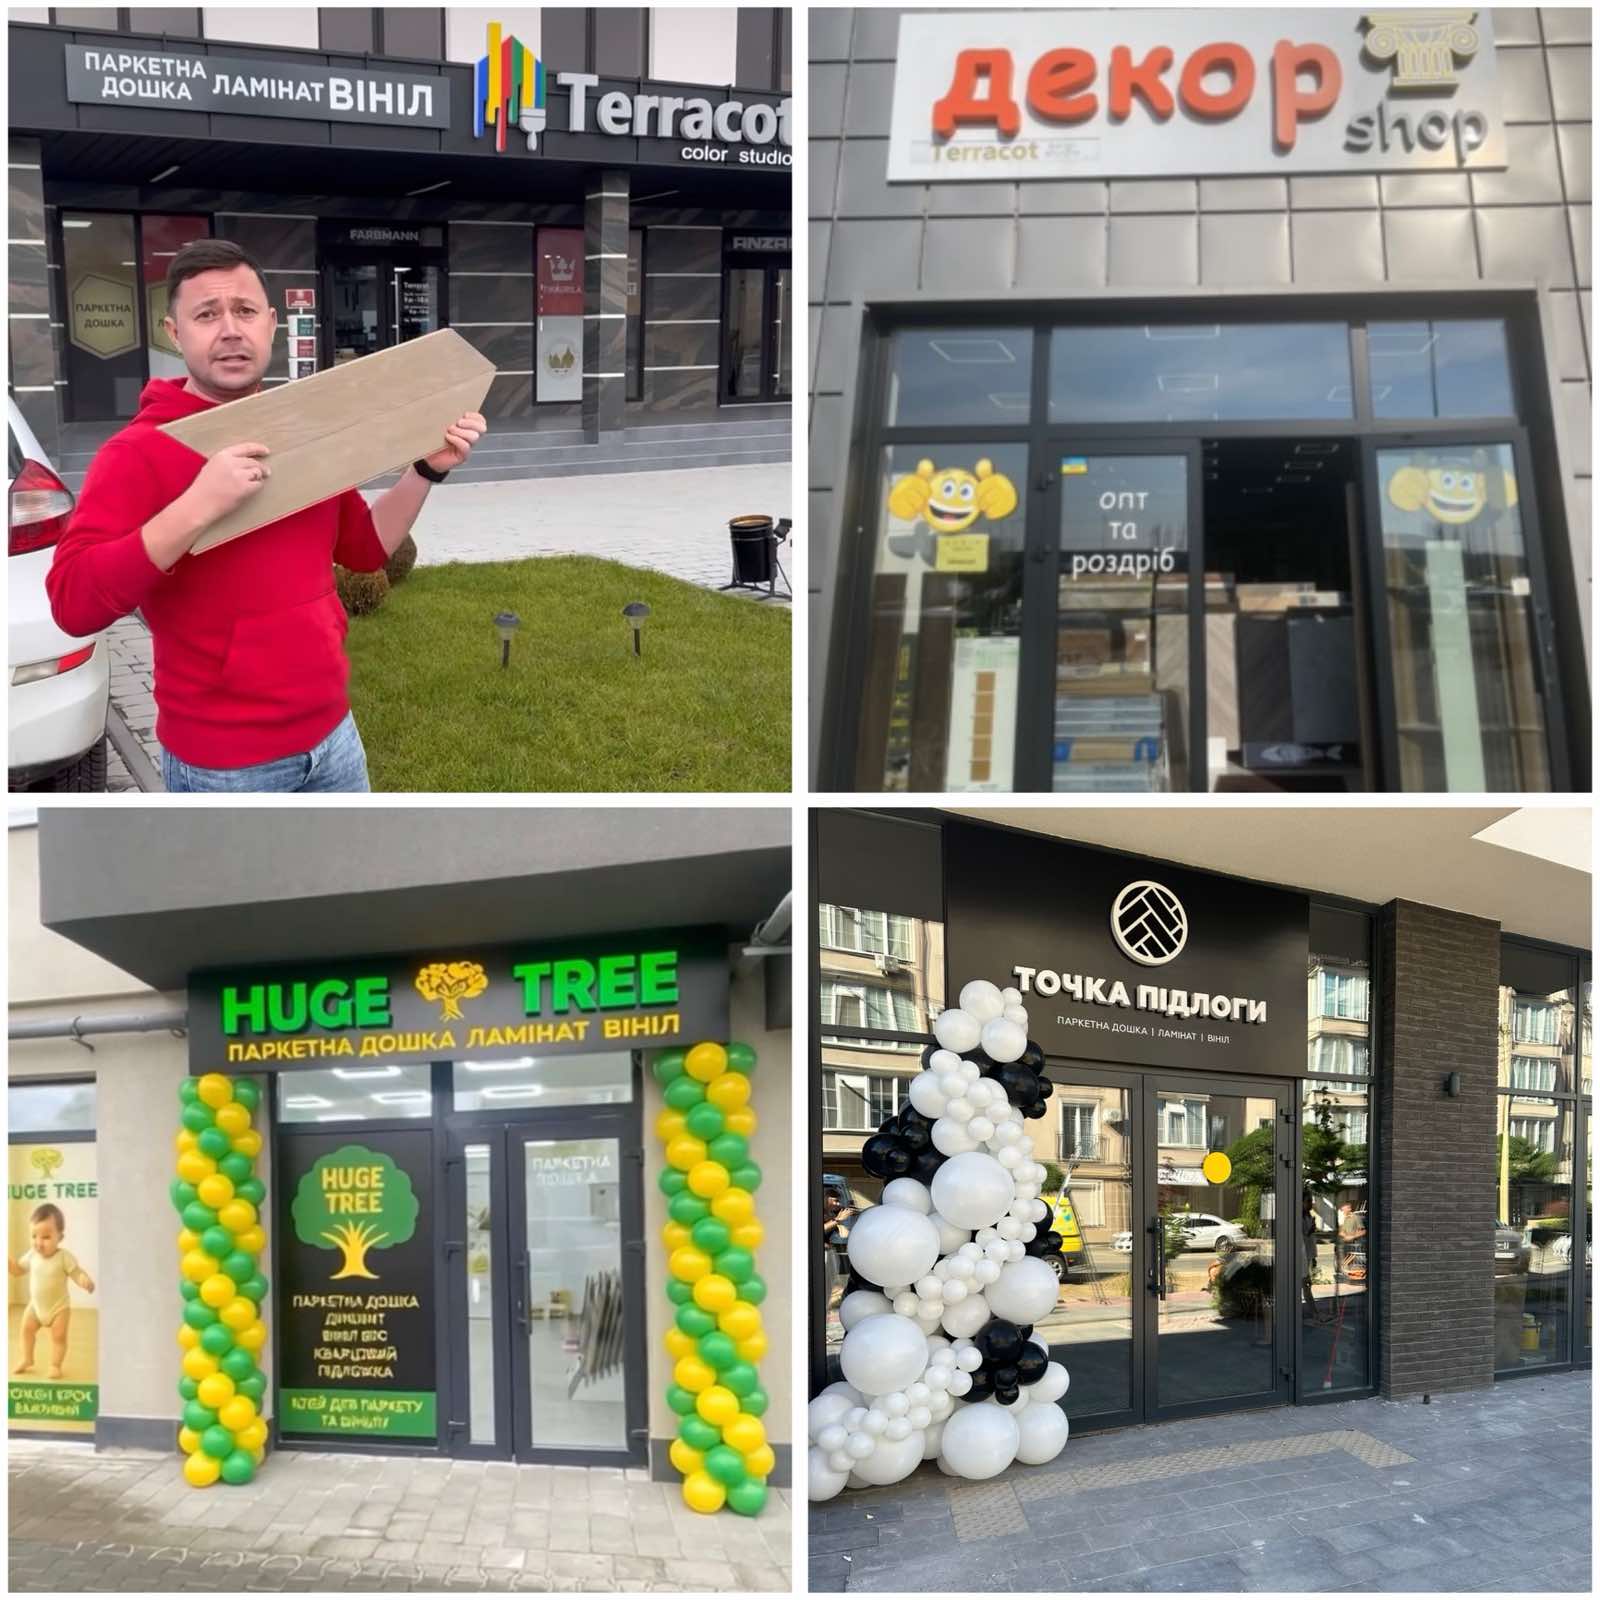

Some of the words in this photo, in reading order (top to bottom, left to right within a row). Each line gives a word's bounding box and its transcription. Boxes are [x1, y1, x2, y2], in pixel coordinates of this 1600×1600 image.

[84, 52, 207, 80] ПАРКЕТНА
[101, 76, 192, 101] ДОШКА
[212, 73, 325, 103] ЛАМІНАТ
[328, 77, 433, 117] ВІНІЛ
[931, 39, 1342, 153] декор
[1343, 101, 1488, 168] shop
[681, 145, 728, 161] color
[739, 149, 792, 165] studio
[932, 142, 1039, 162] Terracot
[733, 236, 792, 249] ANZA
[75, 303, 132, 314] ПАРКЕТНА
[84, 319, 126, 329] ДОШКА
[1099, 490, 1149, 510] опт
[1108, 521, 1137, 540] та
[1072, 546, 1176, 581] роздріб
[223, 976, 392, 1036] HUGE
[513, 951, 680, 1015] TREE
[1013, 965, 1131, 1007] ТОЧКА
[1136, 984, 1267, 1023] ПІДЛОГИ
[228, 1036, 354, 1063] ПАРКЕТНА
[359, 1027, 457, 1059] ДОШКА
[466, 1020, 590, 1049] ЛАМІНАТ
[603, 1013, 681, 1040] ВІНІЛ
[1057, 1016, 1109, 1031] ПАРКЕТНА
[1112, 1022, 1148, 1036] ДОШКА
[1158, 1027, 1196, 1041] ЛАМІНАТ
[1207, 1033, 1231, 1044] ВІНІЛ
[321, 1165, 384, 1190] HUGE
[8, 1183, 47, 1200] UGE
[53, 1182, 98, 1199] TREE
[324, 1191, 384, 1214] TREE
